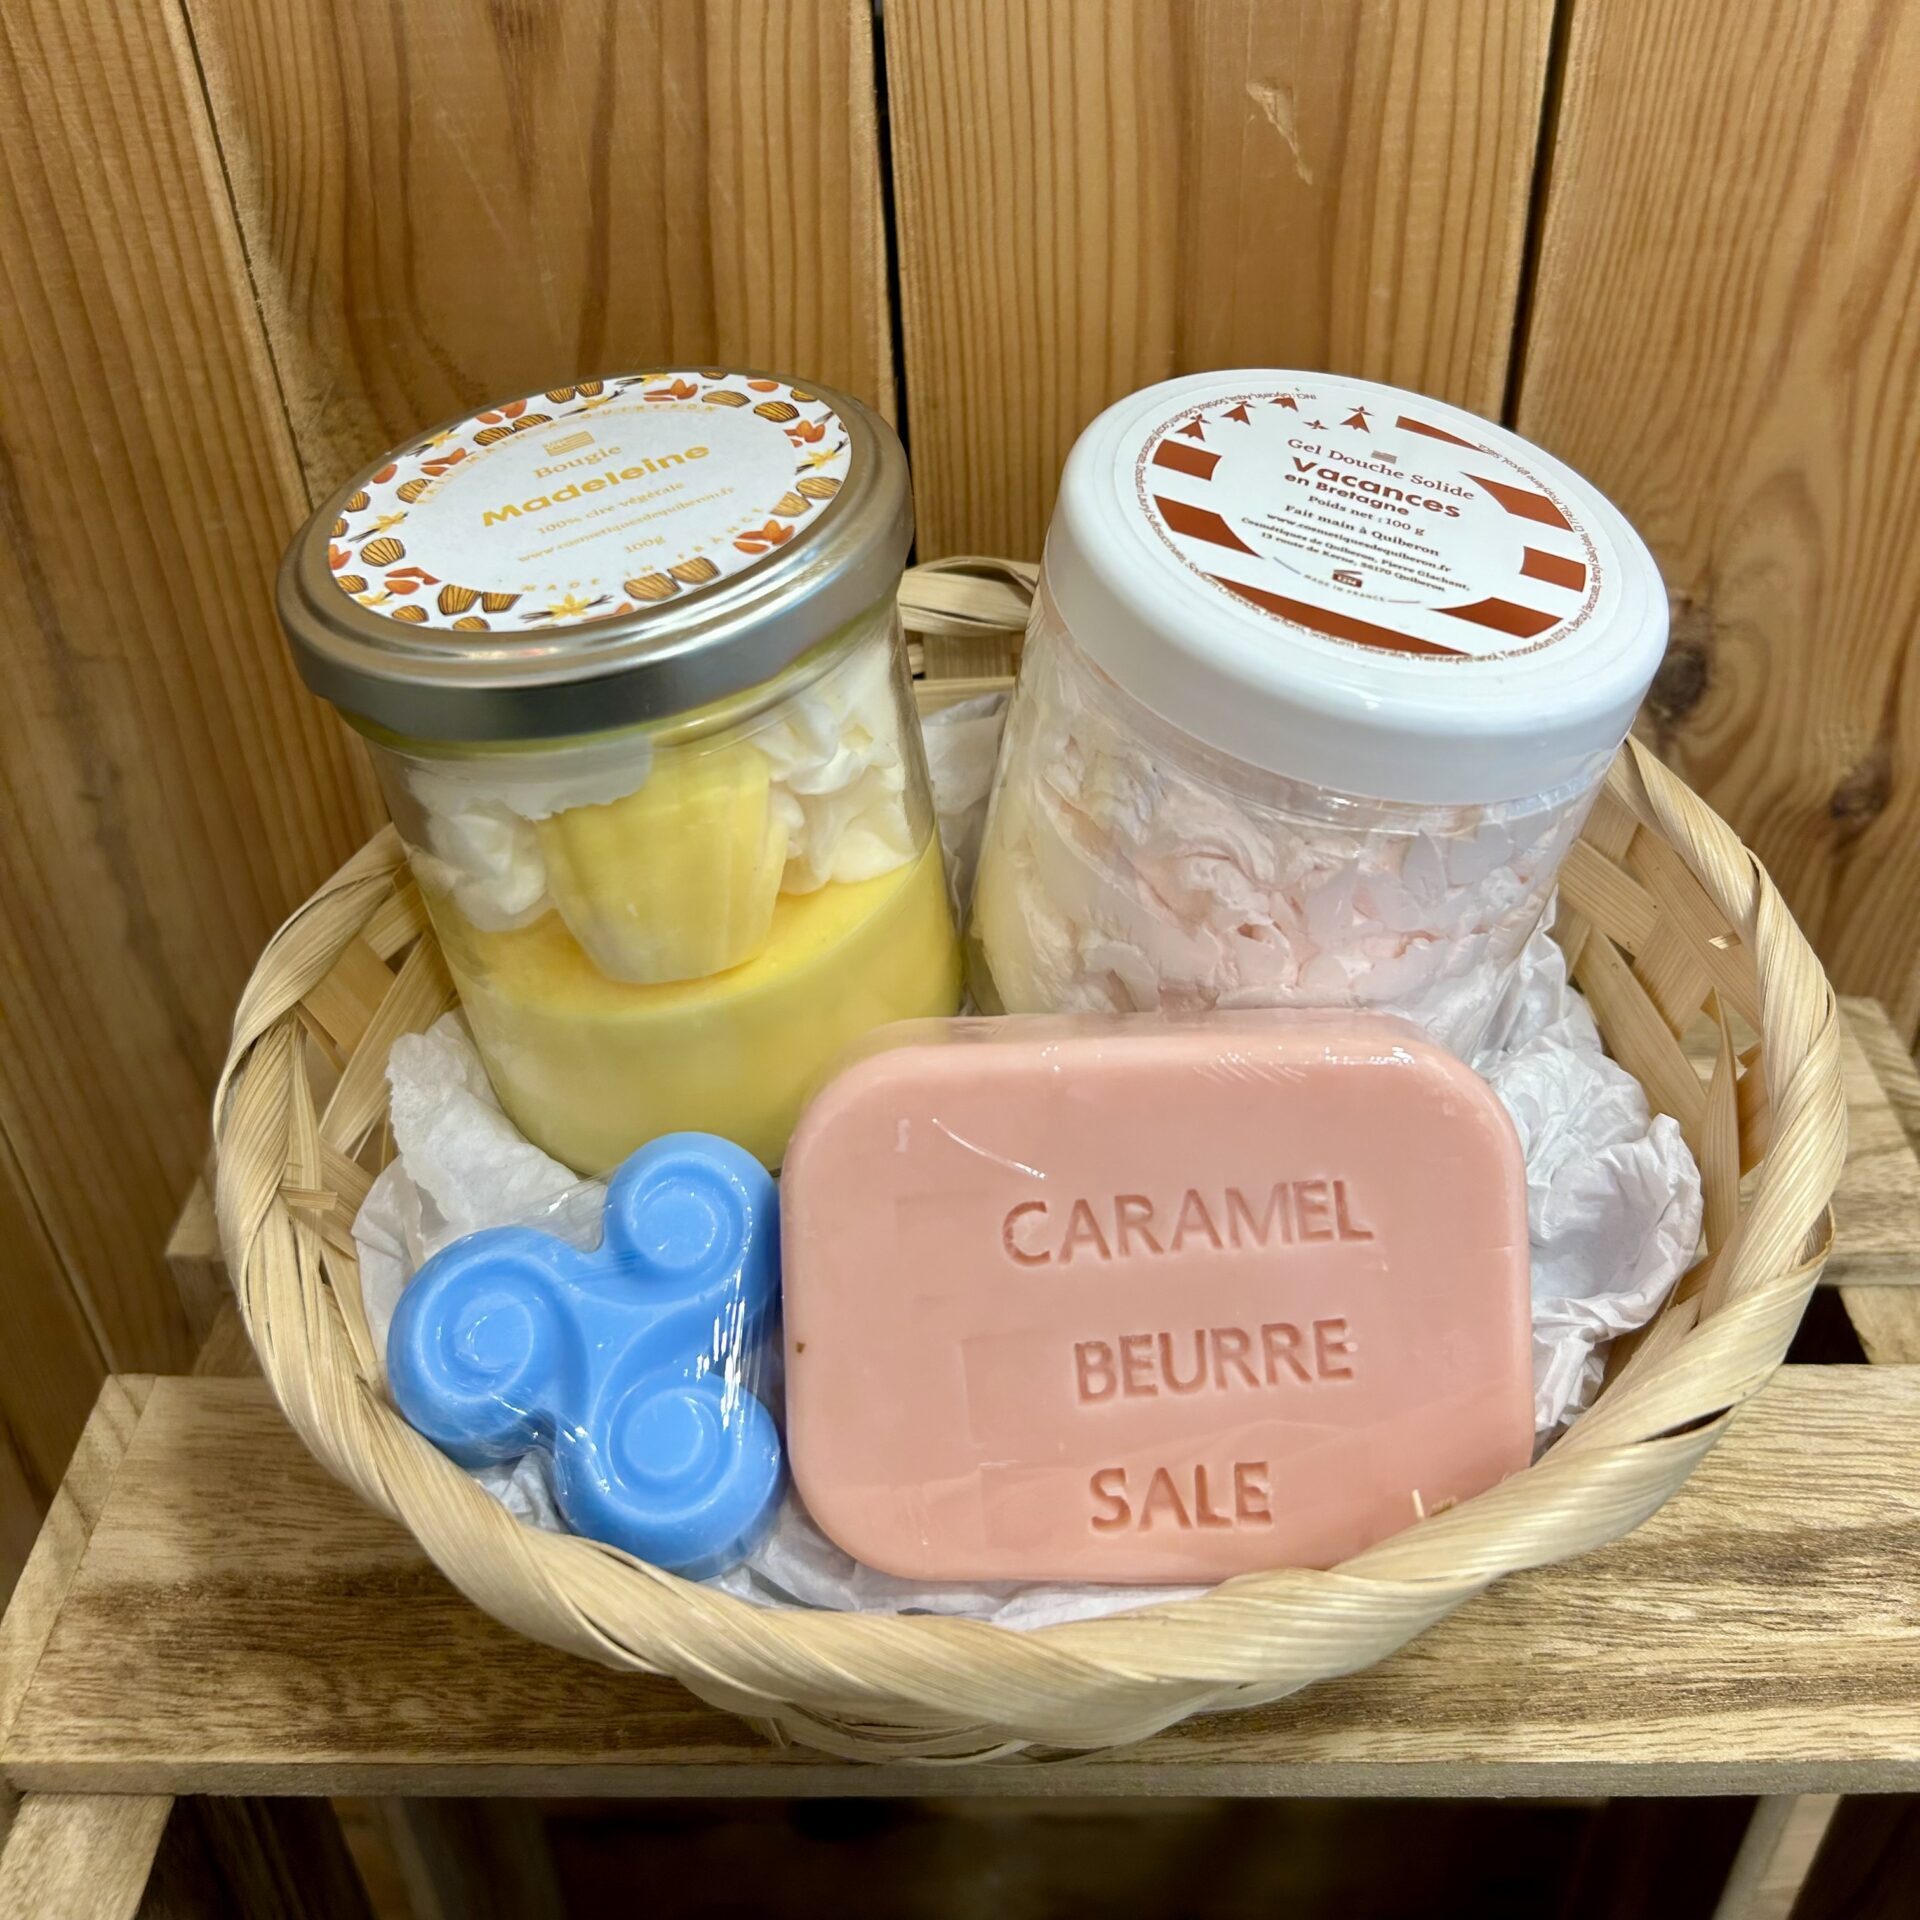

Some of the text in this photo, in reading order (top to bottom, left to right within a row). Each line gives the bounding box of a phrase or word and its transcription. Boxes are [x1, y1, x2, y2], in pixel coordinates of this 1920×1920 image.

[482, 446, 710, 527] Madeleine
[534, 446, 622, 478] Bougie
[1287, 438, 1322, 456] Gel
[1328, 450, 1404, 480] Douche
[1410, 473, 1475, 500] Solide
[1292, 456, 1461, 518] Vacances
[1284, 473, 1409, 516] en Bretagne
[1308, 495, 1346, 512] Poids
[1350, 507, 1374, 521] net
[1414, 527, 1426, 536] g
[1284, 504, 1440, 557] Fait main à Quiberon
[1001, 1180, 1374, 1267] CARAMEL
[1074, 1319, 1356, 1404] BEURRE
[1089, 1462, 1273, 1532] SALE
